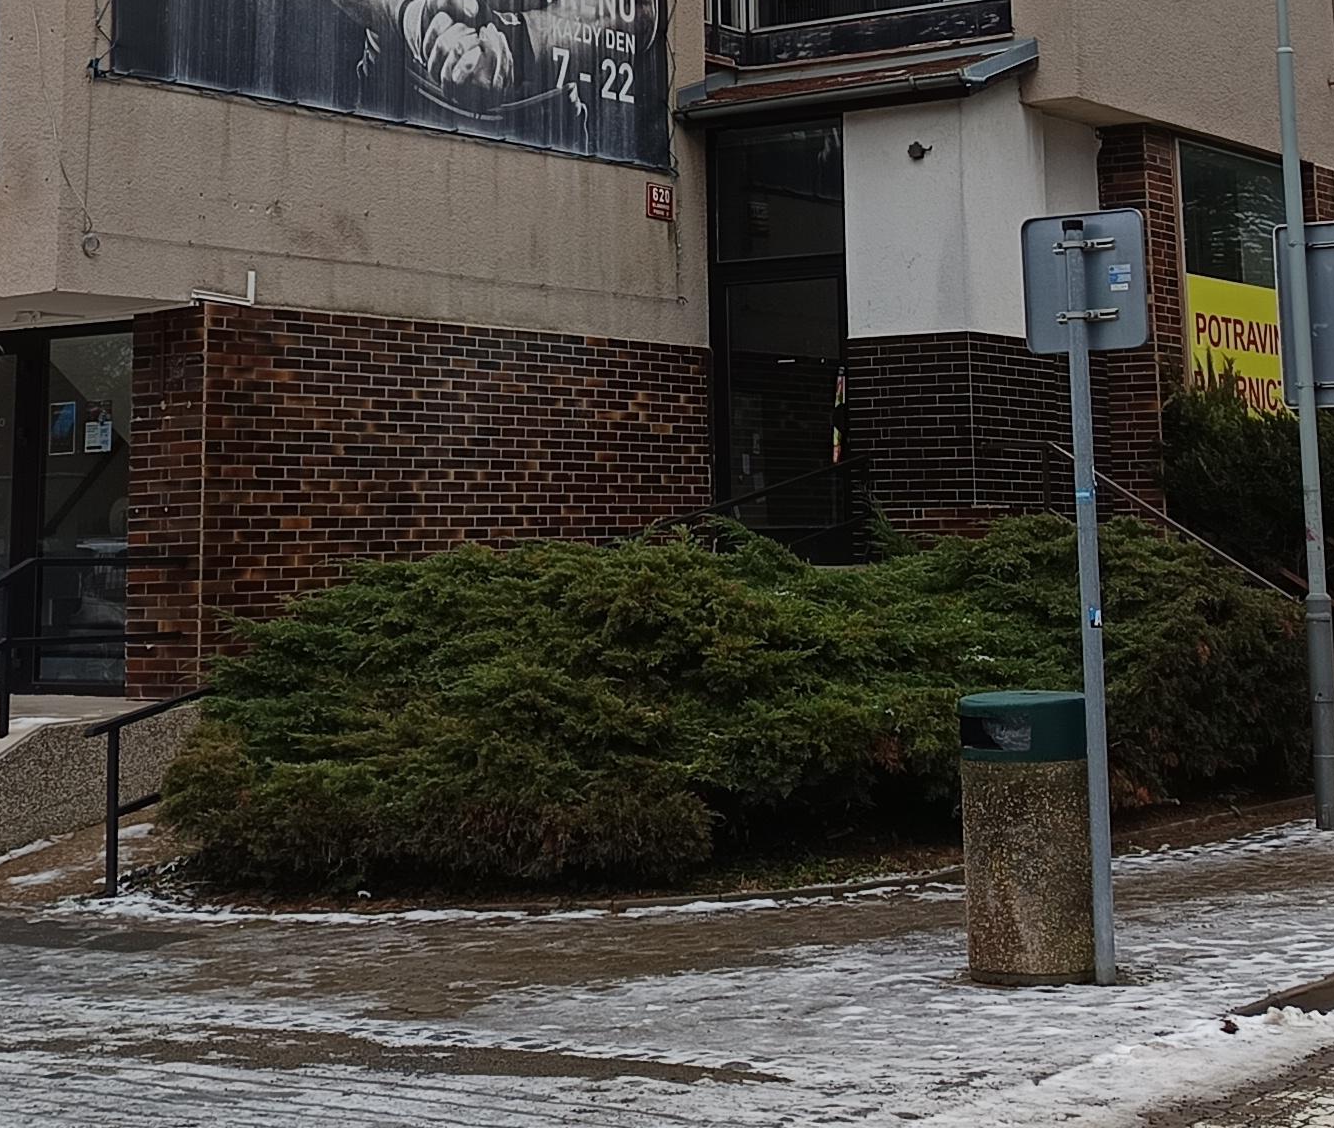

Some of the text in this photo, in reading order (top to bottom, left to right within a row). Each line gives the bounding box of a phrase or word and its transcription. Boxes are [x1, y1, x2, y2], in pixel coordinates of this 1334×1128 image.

[553, 15, 635, 55] KAŽDÝ DEN
[553, 47, 570, 89] 7
[601, 58, 635, 104] 22
[652, 187, 671, 203] 620
